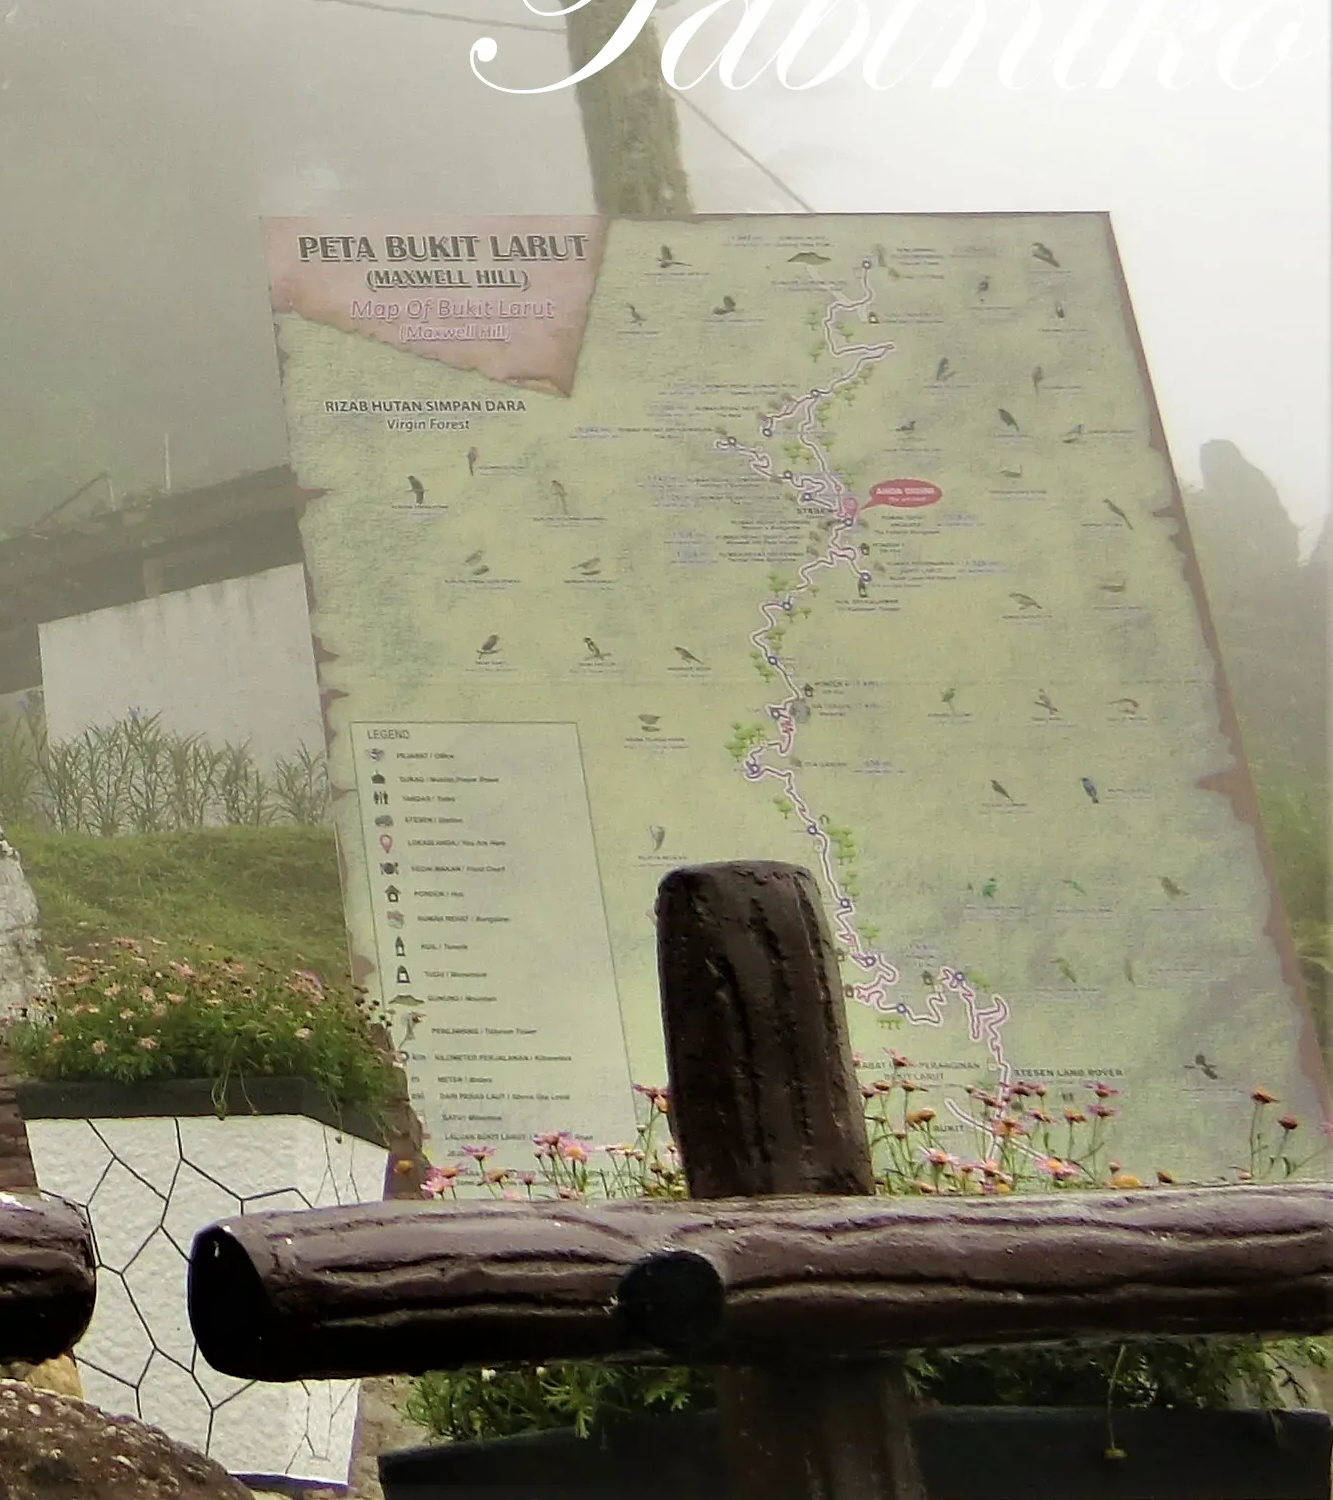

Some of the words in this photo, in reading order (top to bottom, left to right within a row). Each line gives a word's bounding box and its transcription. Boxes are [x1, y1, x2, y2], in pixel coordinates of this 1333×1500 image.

[298, 235, 375, 262] PETA
[386, 235, 481, 262] BUKIT
[491, 235, 589, 261] LARUT
[366, 269, 472, 290] (MAXWELL
[477, 268, 532, 290] HILL)
[350, 299, 400, 321] Map
[407, 299, 432, 320] Of
[437, 299, 493, 319] Bukit
[498, 300, 556, 319] Larut
[325, 401, 368, 412] RIZAB
[372, 401, 422, 412] HUTAN
[426, 401, 482, 412] SIMPAN
[486, 401, 526, 412] DARA
[387, 418, 426, 431] Virgin
[430, 418, 470, 430] Forest
[367, 729, 410, 740] LEGEND
